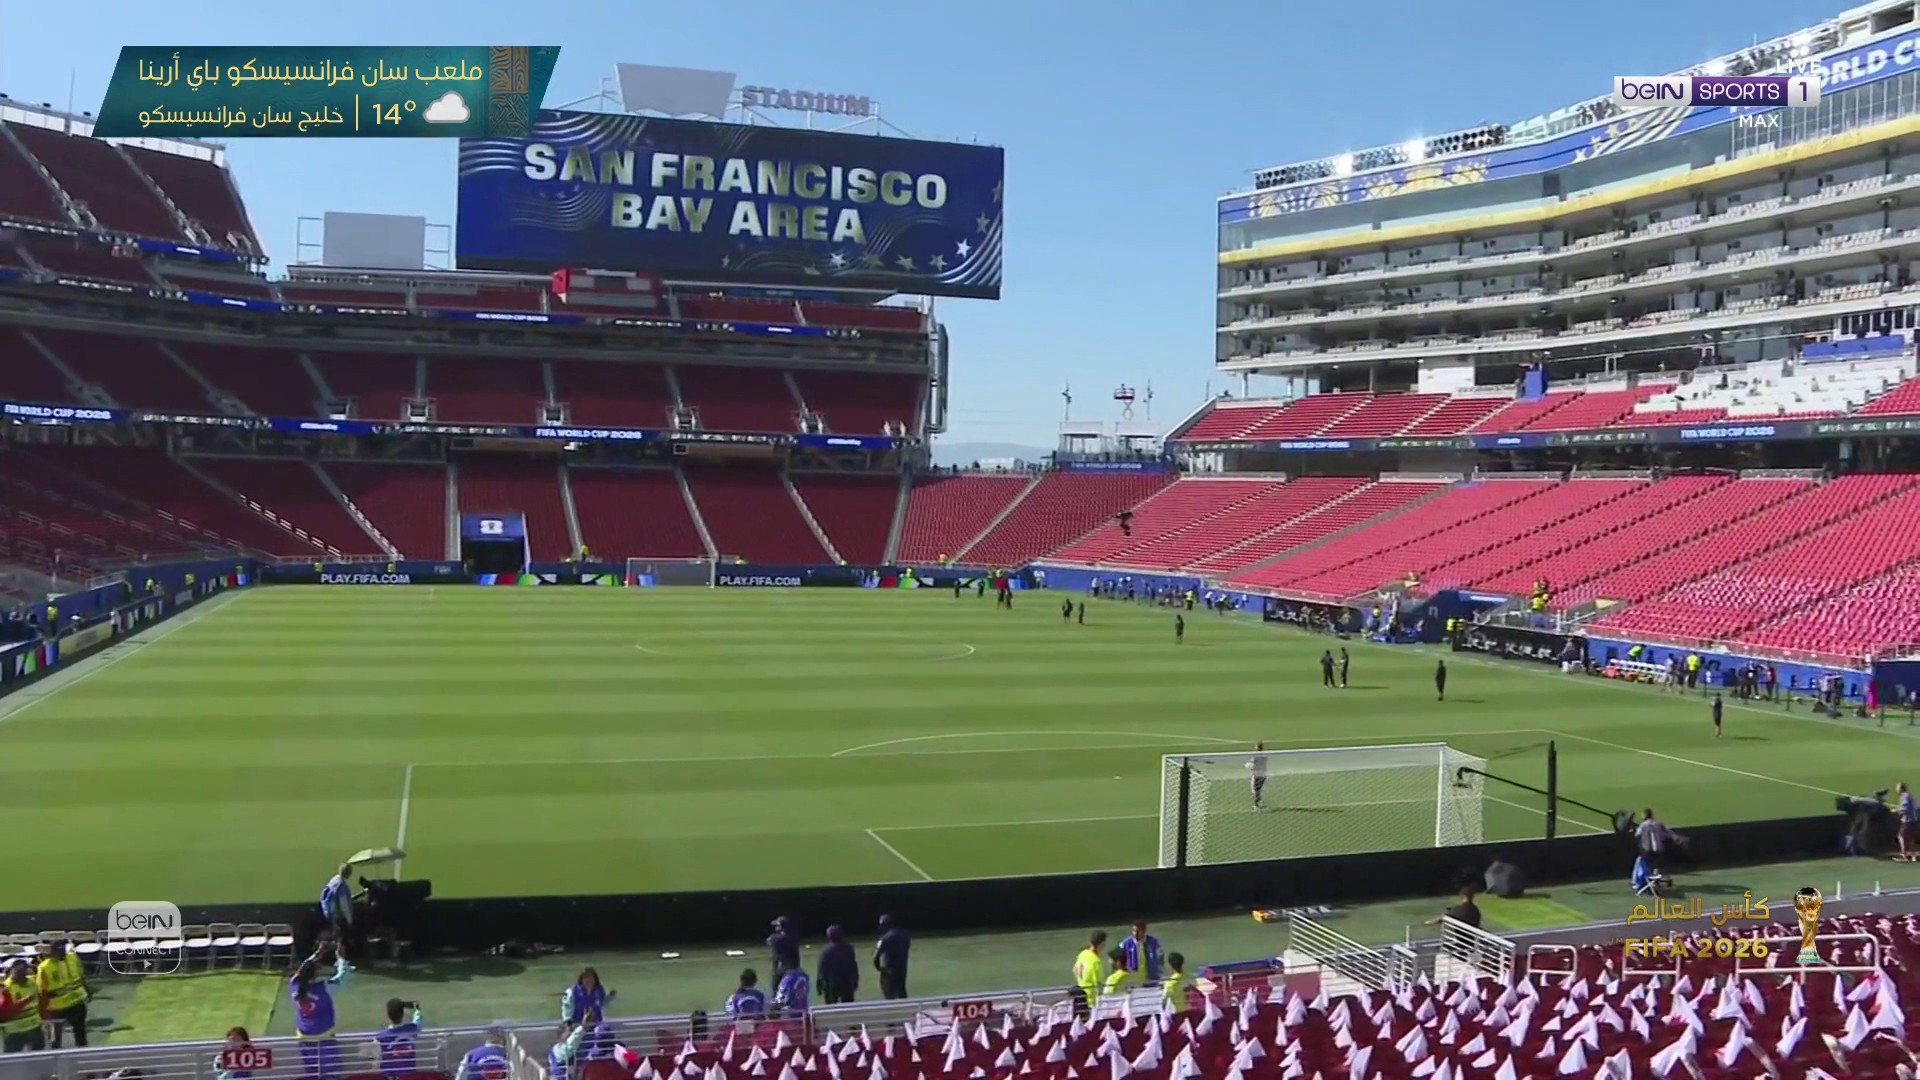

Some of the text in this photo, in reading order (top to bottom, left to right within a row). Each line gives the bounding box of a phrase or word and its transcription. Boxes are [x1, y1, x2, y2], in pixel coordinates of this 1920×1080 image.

[741, 85, 870, 117] STADIUM
[523, 142, 948, 208] SAN FRANCISCO
[610, 193, 868, 246] BAY AREA
[53, 407, 74, 417] CUP
[536, 428, 556, 438] FIFA
[557, 429, 590, 439] WORLD
[591, 430, 609, 439] CUP
[320, 573, 411, 584] PLAY.FIFA.COM
[719, 575, 801, 587] PLAY.FIFA.COM
[956, 1003, 990, 1019] 104
[227, 1050, 269, 1068] 105
